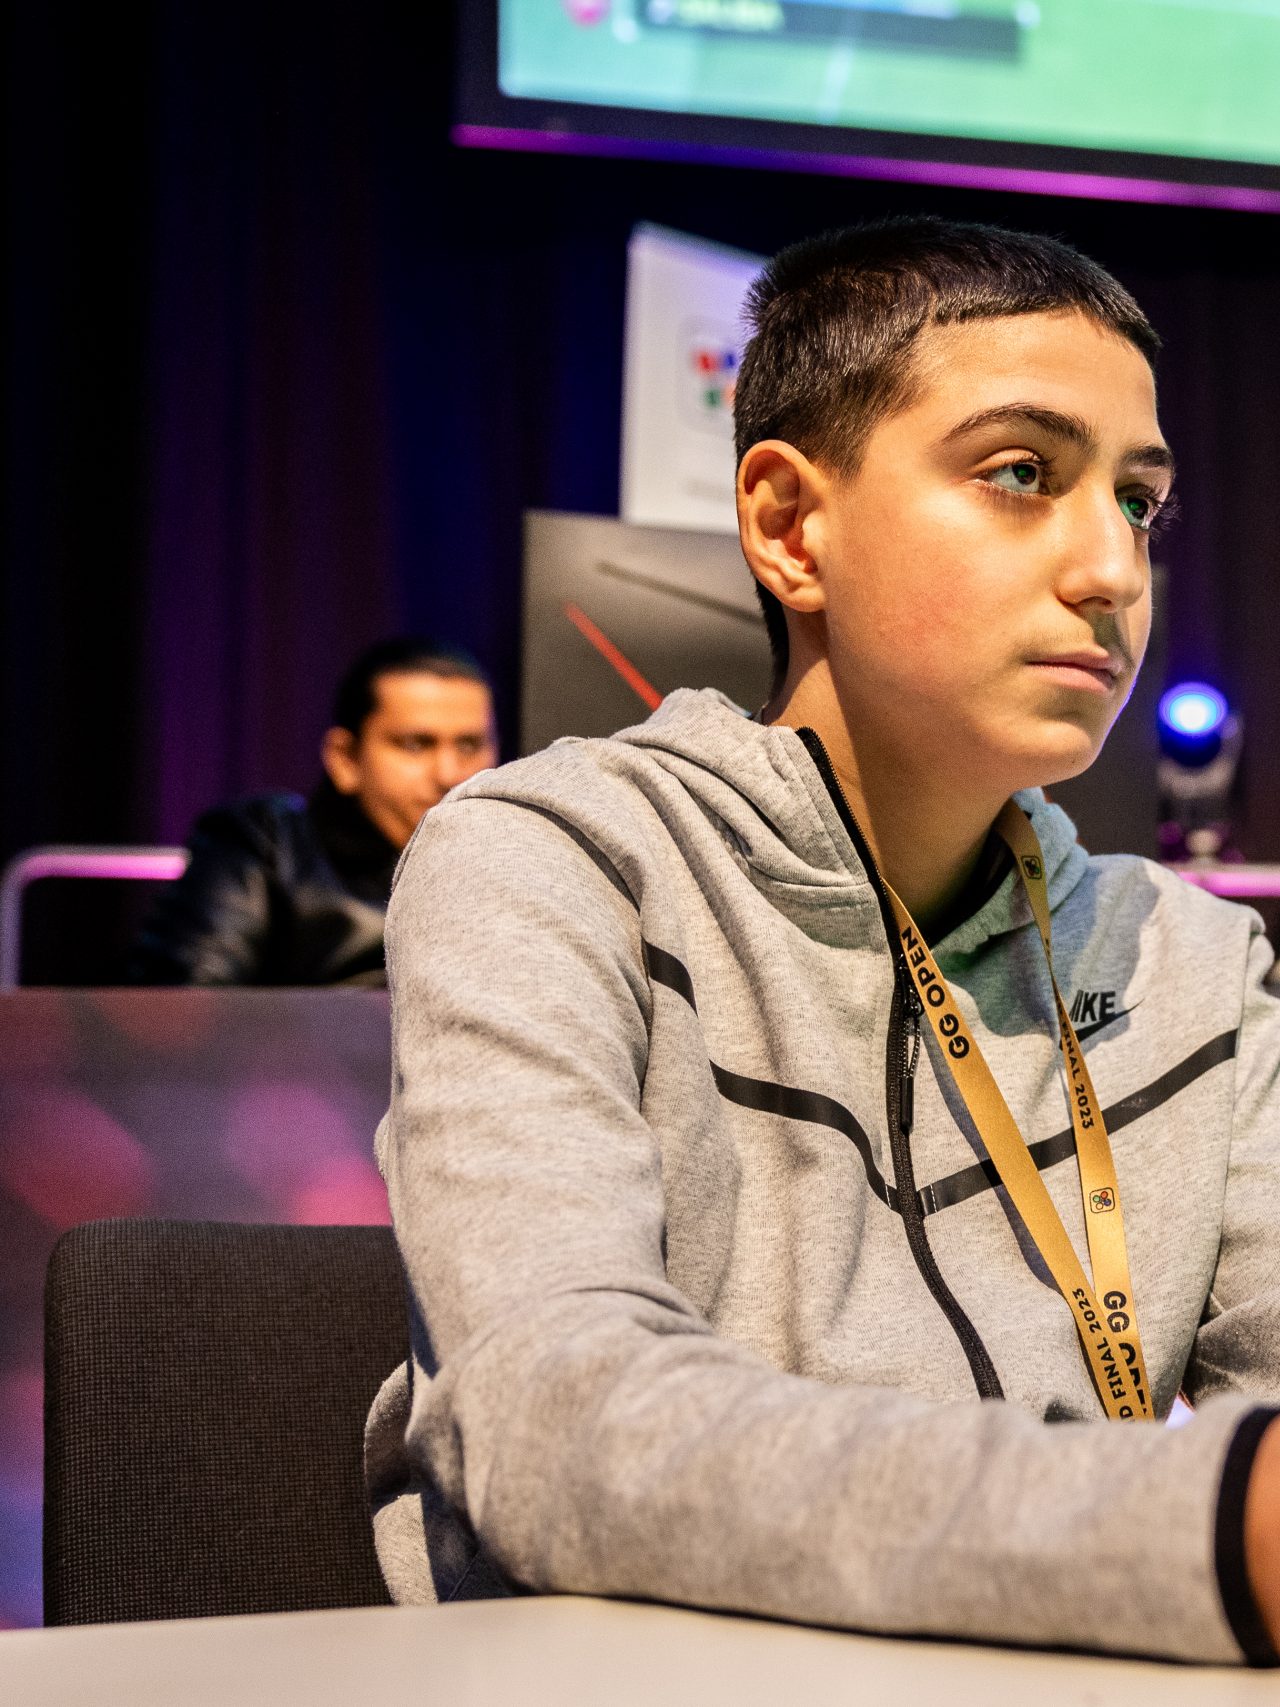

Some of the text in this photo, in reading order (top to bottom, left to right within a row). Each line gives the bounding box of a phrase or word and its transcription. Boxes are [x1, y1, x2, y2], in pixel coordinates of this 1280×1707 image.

[901, 926, 970, 1059] GG OPEN
[1075, 1083, 1094, 1129] 2023
[1072, 1287, 1102, 1333] 2023
[1103, 1290, 1130, 1333] GG
[1096, 1337, 1127, 1400] FINAL
